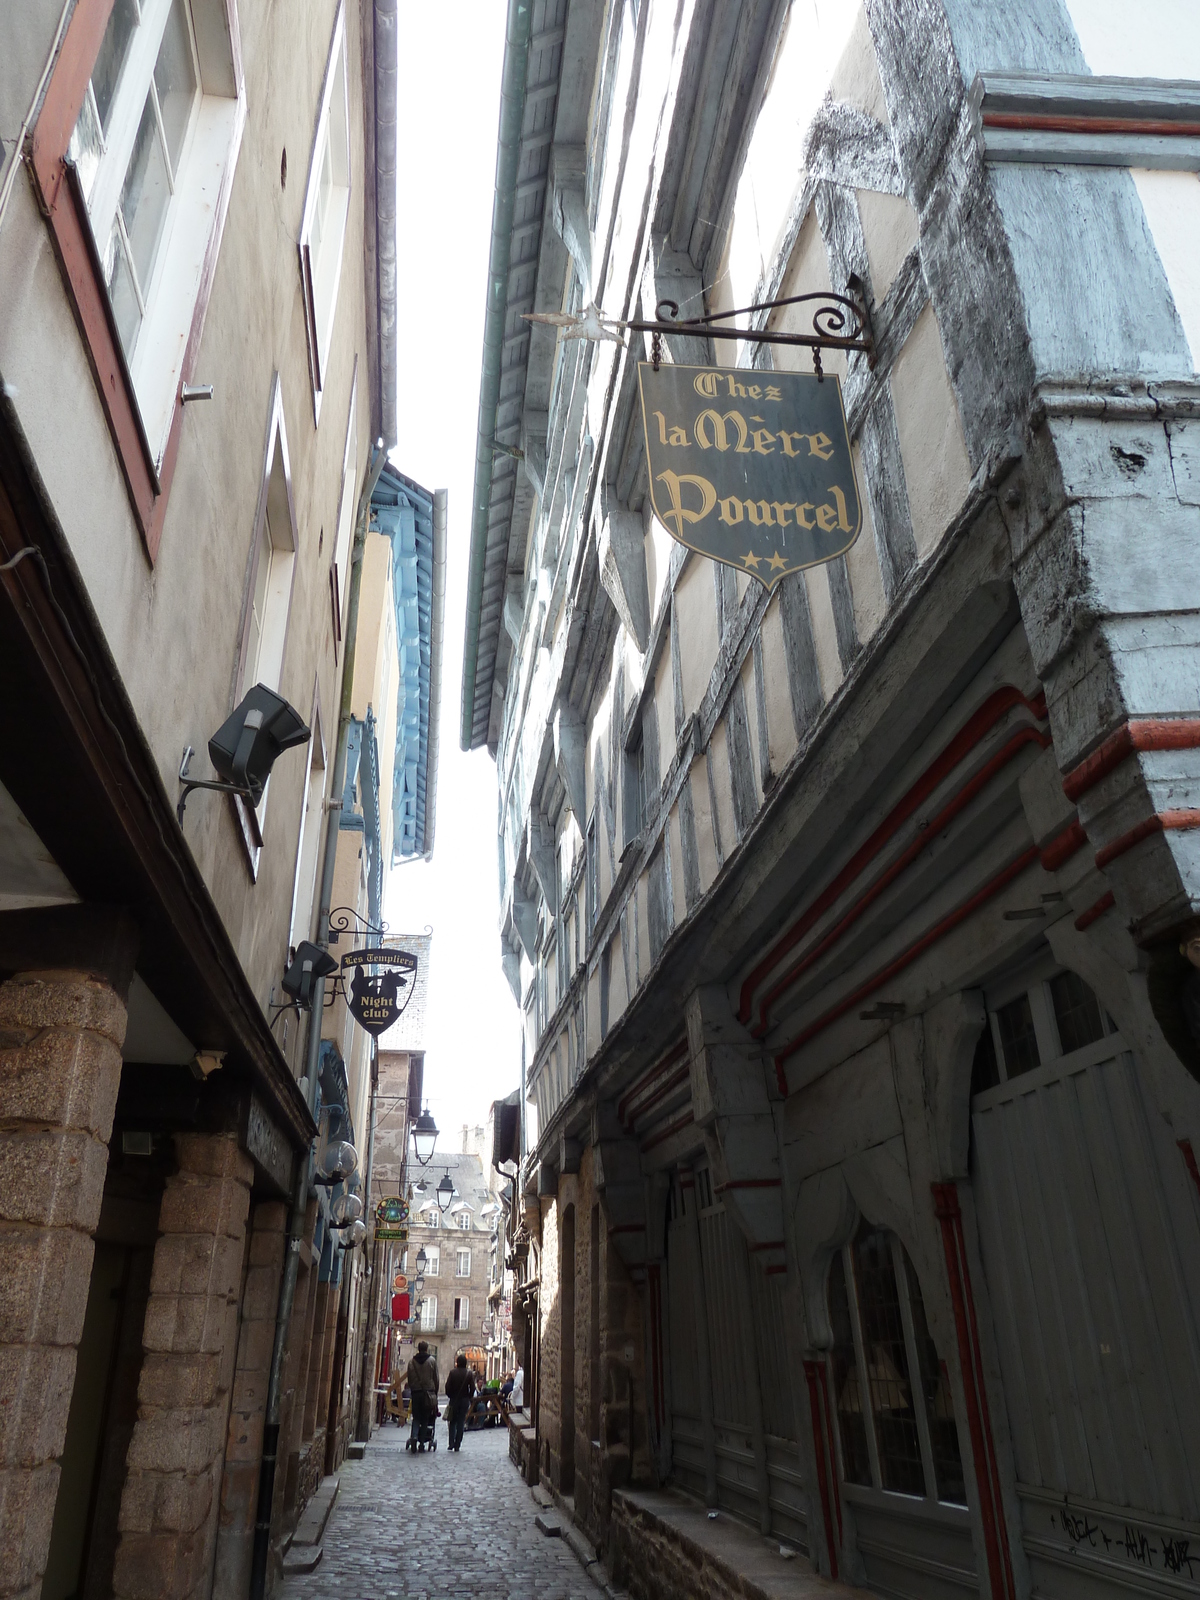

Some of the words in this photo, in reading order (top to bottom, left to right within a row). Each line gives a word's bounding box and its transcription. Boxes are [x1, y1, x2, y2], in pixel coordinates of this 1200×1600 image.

[693, 372, 783, 401] Chez
[652, 411, 692, 446] la
[693, 408, 835, 461] Mère
[655, 469, 853, 537] Pourcel
[344, 956, 363, 965] Les
[366, 953, 414, 966] Templiers
[360, 996, 393, 1008] Night
[363, 1009, 390, 1018] club
